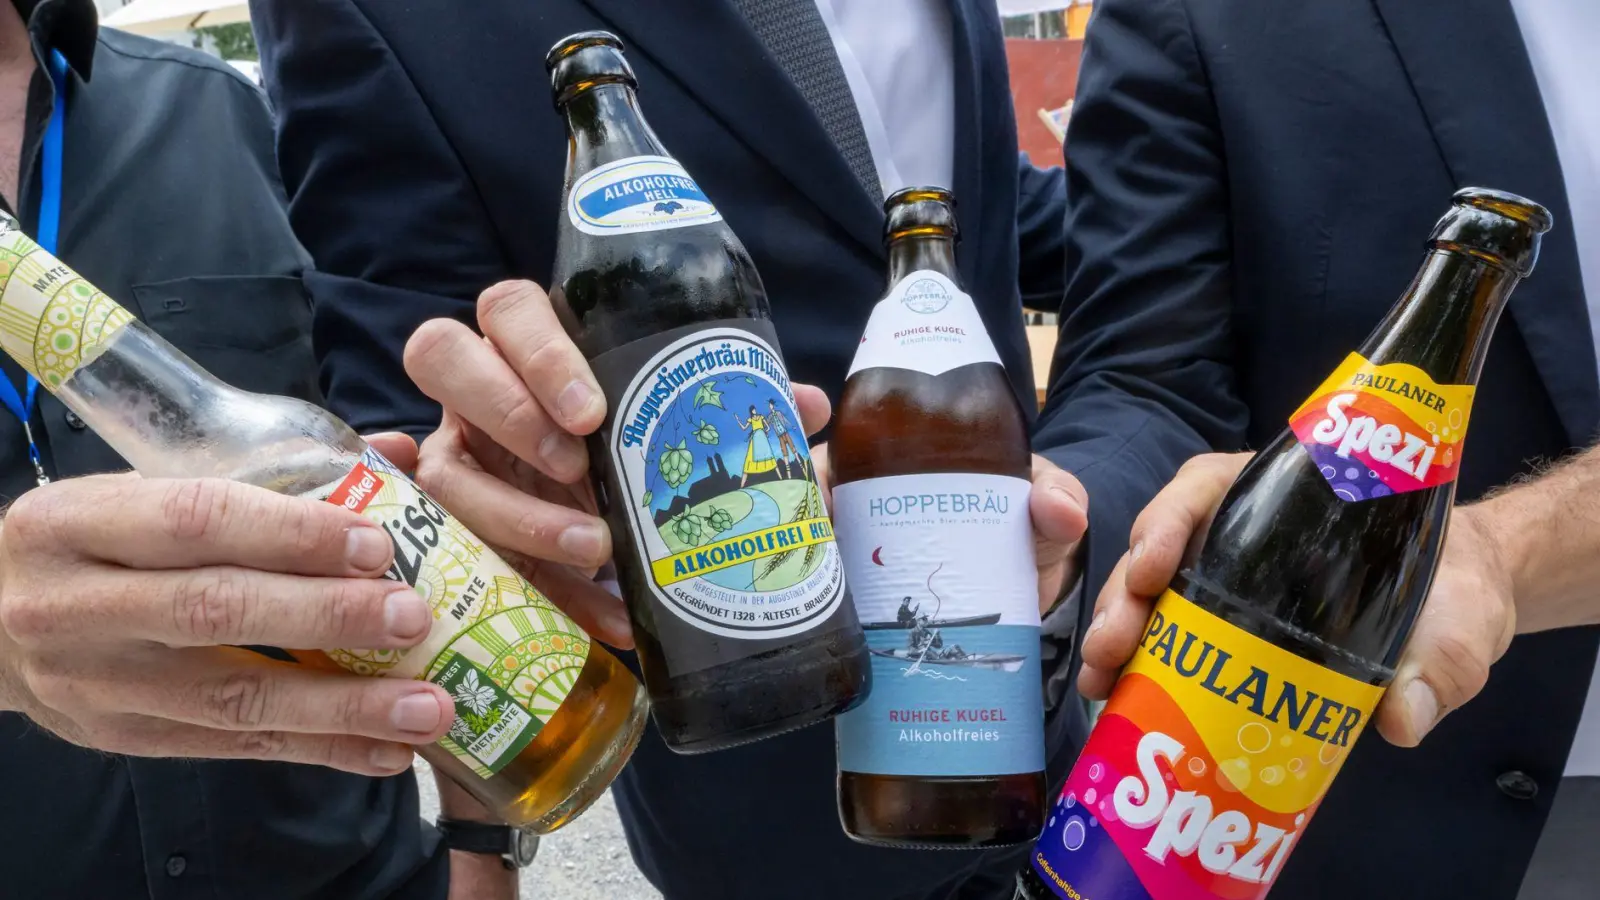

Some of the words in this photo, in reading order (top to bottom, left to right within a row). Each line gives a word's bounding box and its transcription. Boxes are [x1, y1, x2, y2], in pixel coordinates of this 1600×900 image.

[605, 175, 698, 201] ALKOHOLFREI
[644, 189, 678, 202] HELL
[32, 266, 70, 293] MATE
[894, 326, 931, 339] RUHIGE
[934, 325, 966, 336] KUGEL
[1352, 373, 1446, 414] PAULANER
[1312, 393, 1437, 482] Spezi
[340, 471, 377, 510] elkel
[869, 489, 1008, 517] HOPPEBRÄU
[673, 526, 804, 577] ALKOHOLFREI
[451, 576, 485, 621] MATE
[674, 587, 730, 619] GEGRÜNDET
[733, 610, 755, 621] 1328
[763, 606, 801, 621] ÄLTESTE
[804, 583, 833, 611] BRAUEREI
[693, 579, 737, 604] HERGESTELLT
[740, 596, 748, 605] IN
[752, 596, 765, 606] DER
[437, 661, 461, 688] OREST
[1140, 610, 1362, 748] PAULANER
[471, 733, 496, 754] META
[496, 707, 520, 734] MATE
[889, 709, 950, 722] RUHIGE
[956, 708, 1007, 722] KUGEL
[899, 728, 1000, 742] Alkoholfreies
[1113, 731, 1305, 884] Spezi
[1036, 852, 1080, 900] Coffeinhaltige
